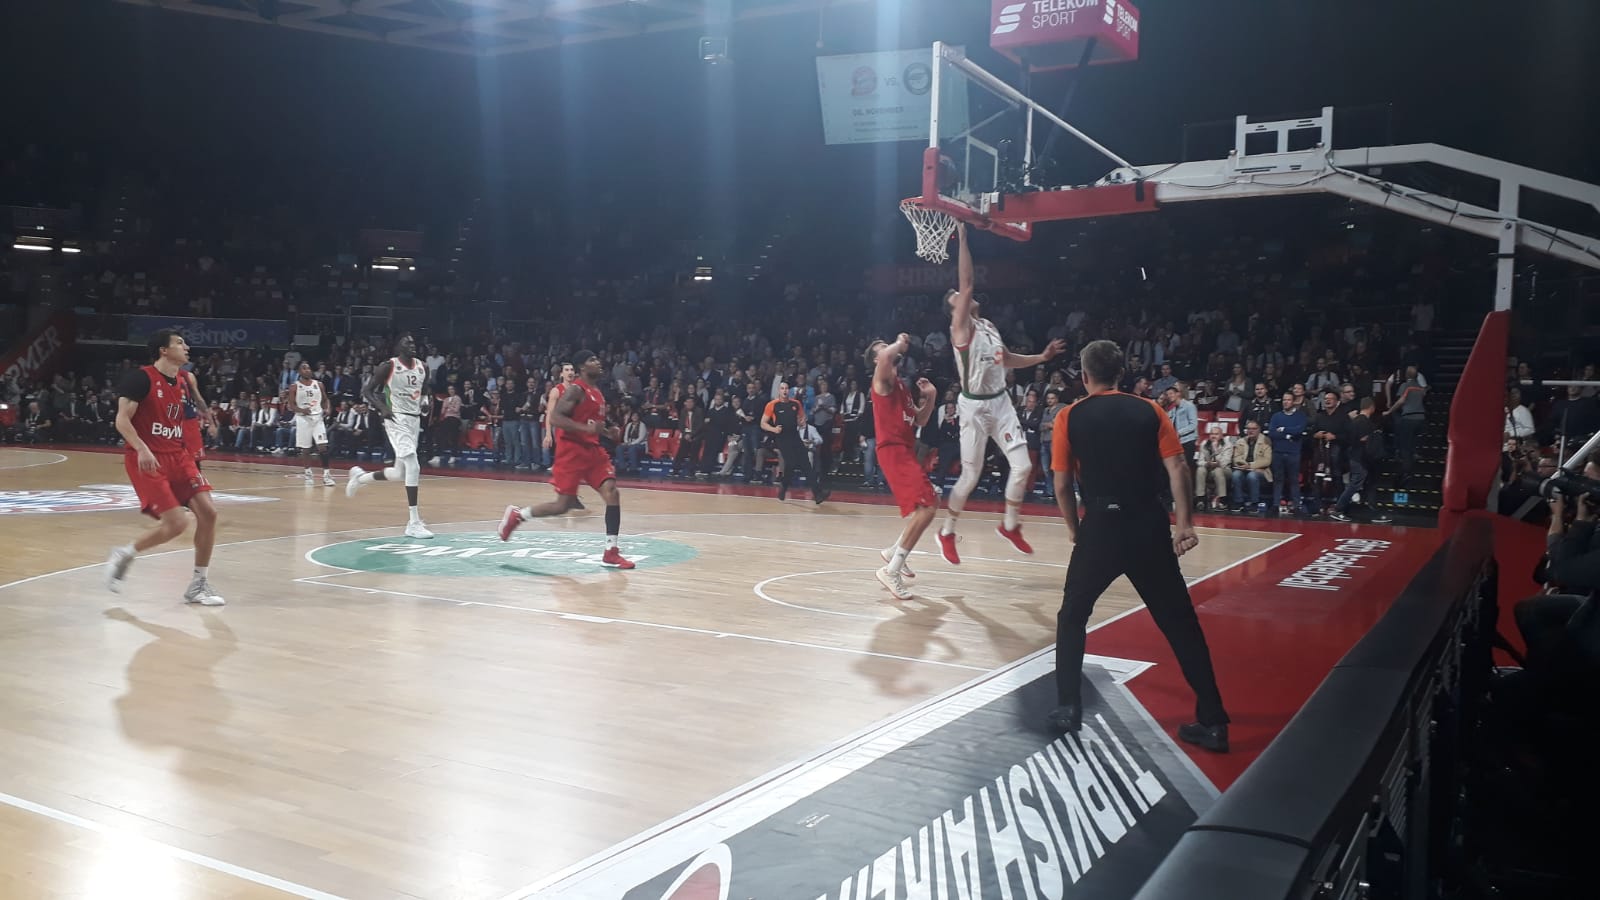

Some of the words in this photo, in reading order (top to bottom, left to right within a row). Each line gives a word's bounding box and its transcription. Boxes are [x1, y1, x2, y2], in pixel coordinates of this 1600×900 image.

[1032, 0, 1099, 13] TELEKOM
[1031, 10, 1078, 29] SPORT
[896, 264, 989, 287] HIRMR
[406, 375, 417, 386] 12
[979, 713, 1167, 900] TURKISH
